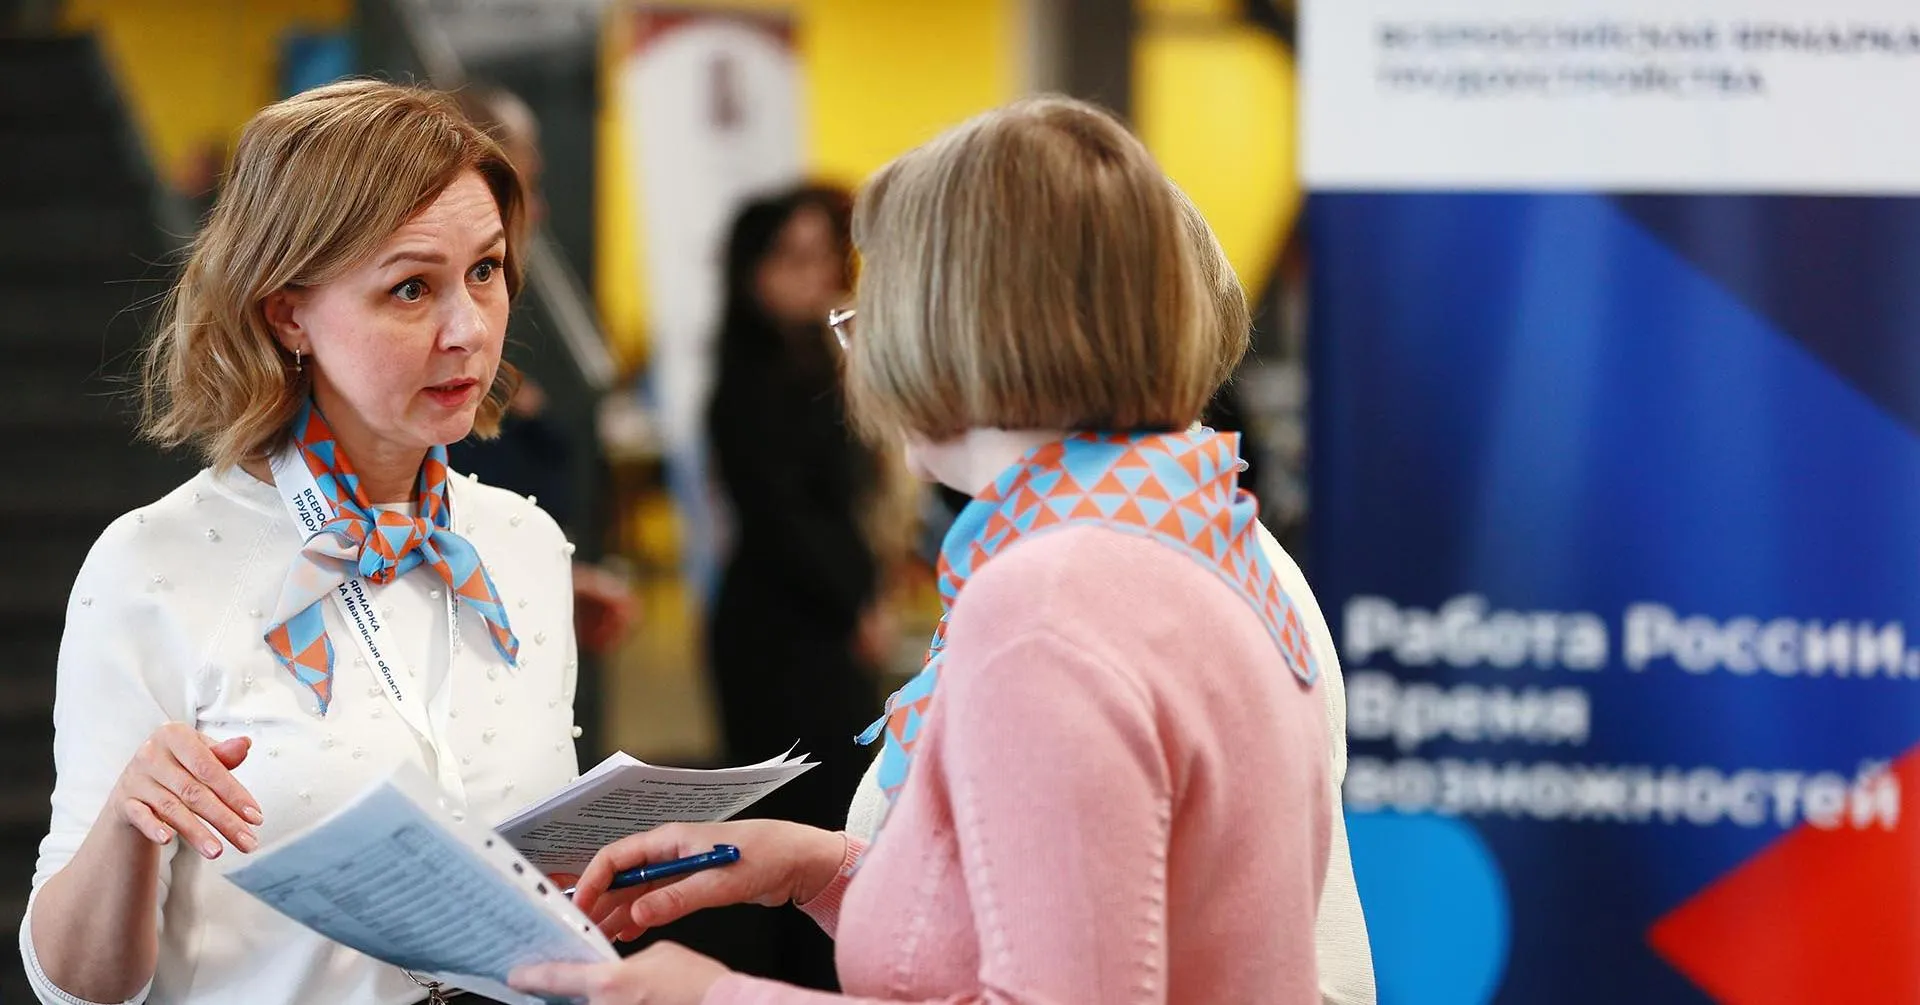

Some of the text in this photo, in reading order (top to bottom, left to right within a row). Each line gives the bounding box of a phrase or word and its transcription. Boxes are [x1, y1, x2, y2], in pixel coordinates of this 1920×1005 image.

[349, 579, 380, 632] ЯРМАРКА
[1345, 597, 1606, 668] Работа
[344, 597, 380, 658] Ивановская
[378, 660, 402, 701] область
[1347, 672, 1590, 750] Время
[1345, 757, 1899, 828] возможностей
